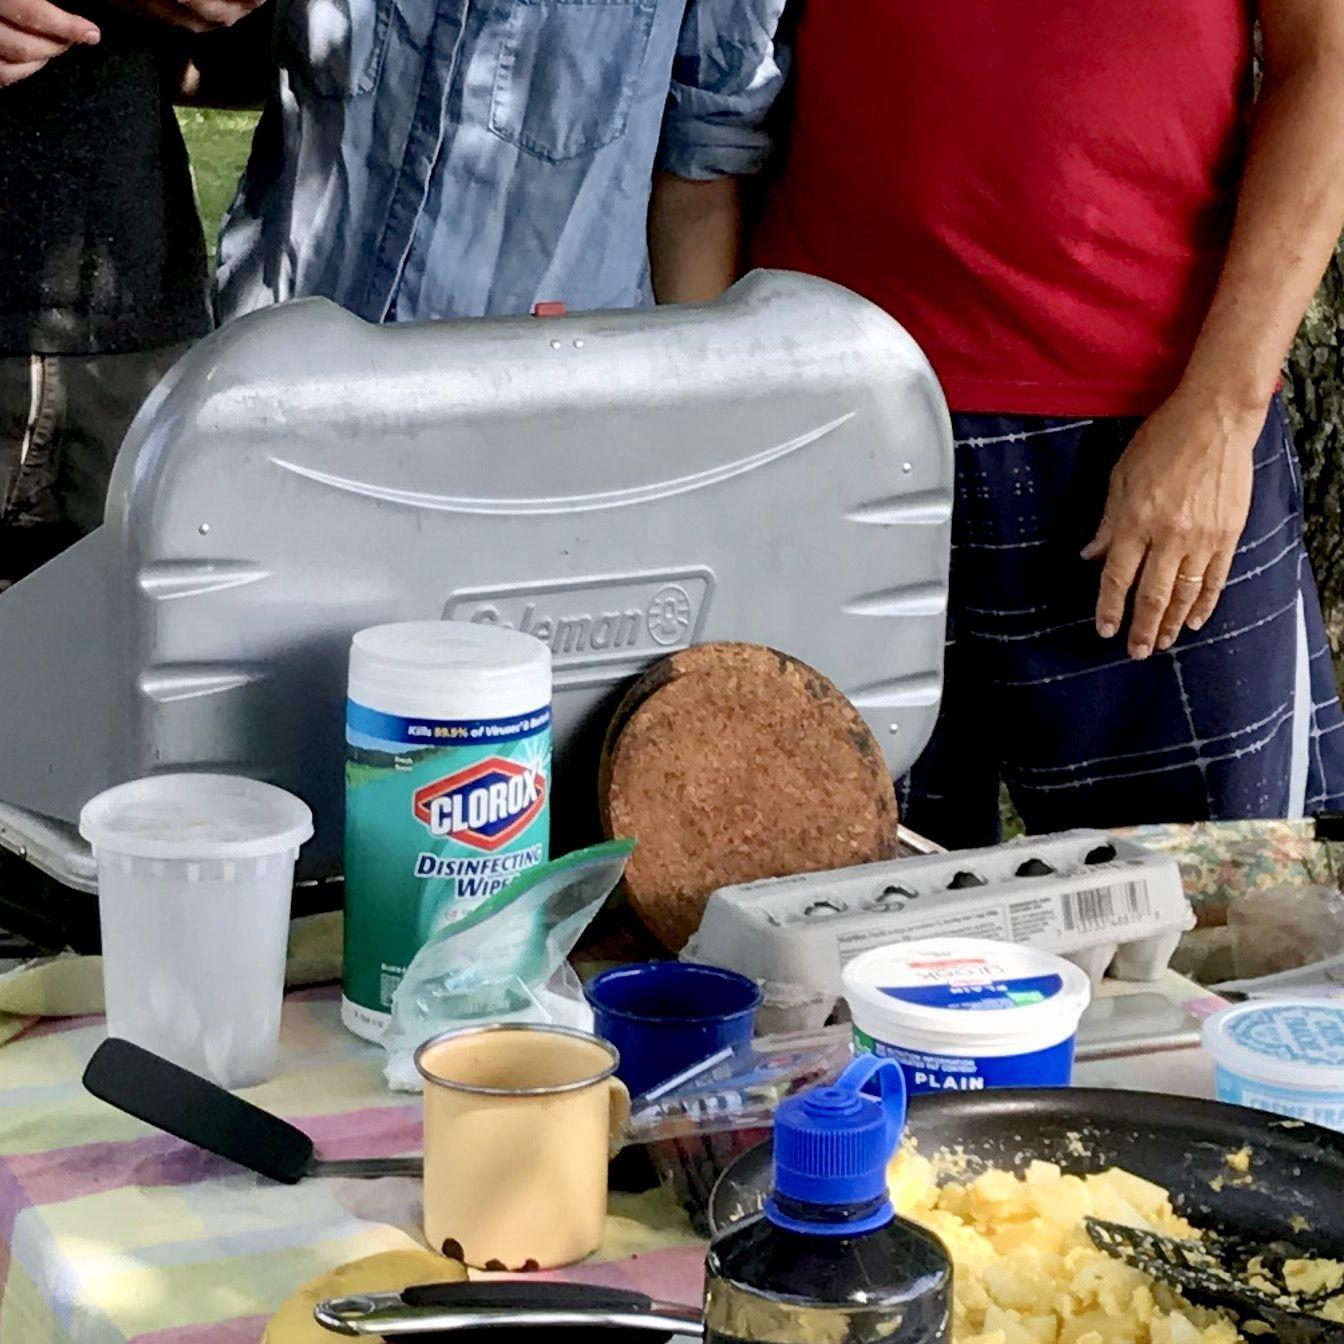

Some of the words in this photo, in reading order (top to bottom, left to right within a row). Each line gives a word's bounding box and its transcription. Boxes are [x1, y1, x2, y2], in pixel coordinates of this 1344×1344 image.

[408, 725, 432, 737] Kills
[434, 726, 469, 738] 99.9%
[470, 726, 484, 737] of
[430, 760, 540, 836] CLOROX
[915, 1072, 984, 1091] PLAIN
